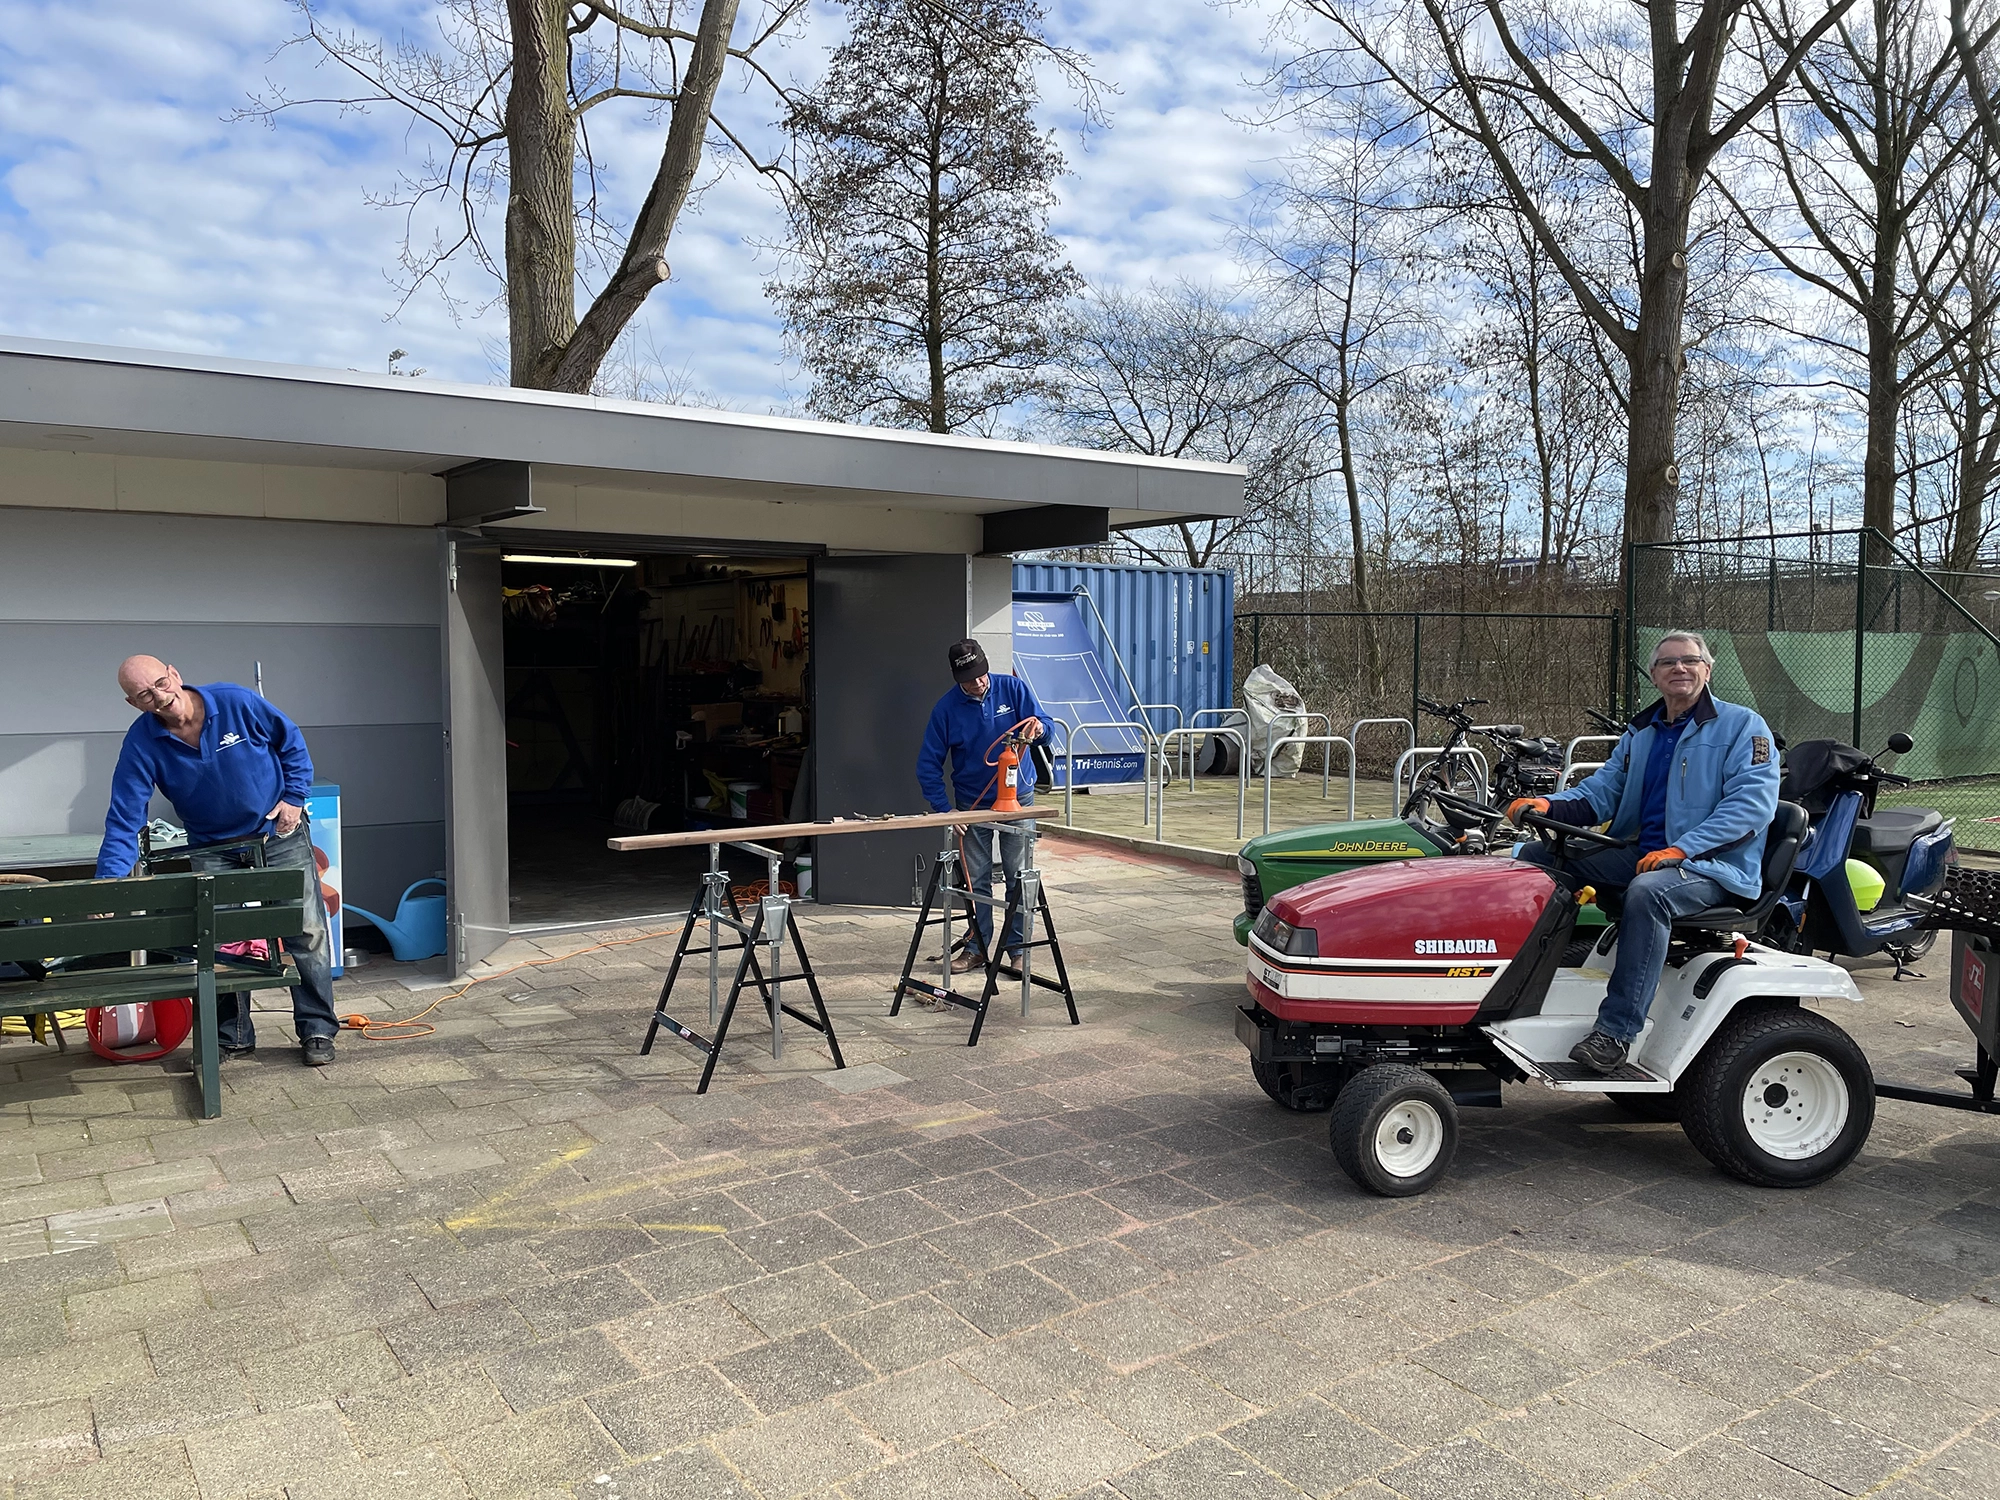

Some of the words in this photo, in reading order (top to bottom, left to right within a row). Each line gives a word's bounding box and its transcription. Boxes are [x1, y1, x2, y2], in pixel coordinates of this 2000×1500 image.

[1329, 840, 1364, 852] JOHN
[1365, 840, 1408, 852] DEERE
[1414, 939, 1498, 954] SHIBAURA
[1446, 967, 1485, 977] HST
